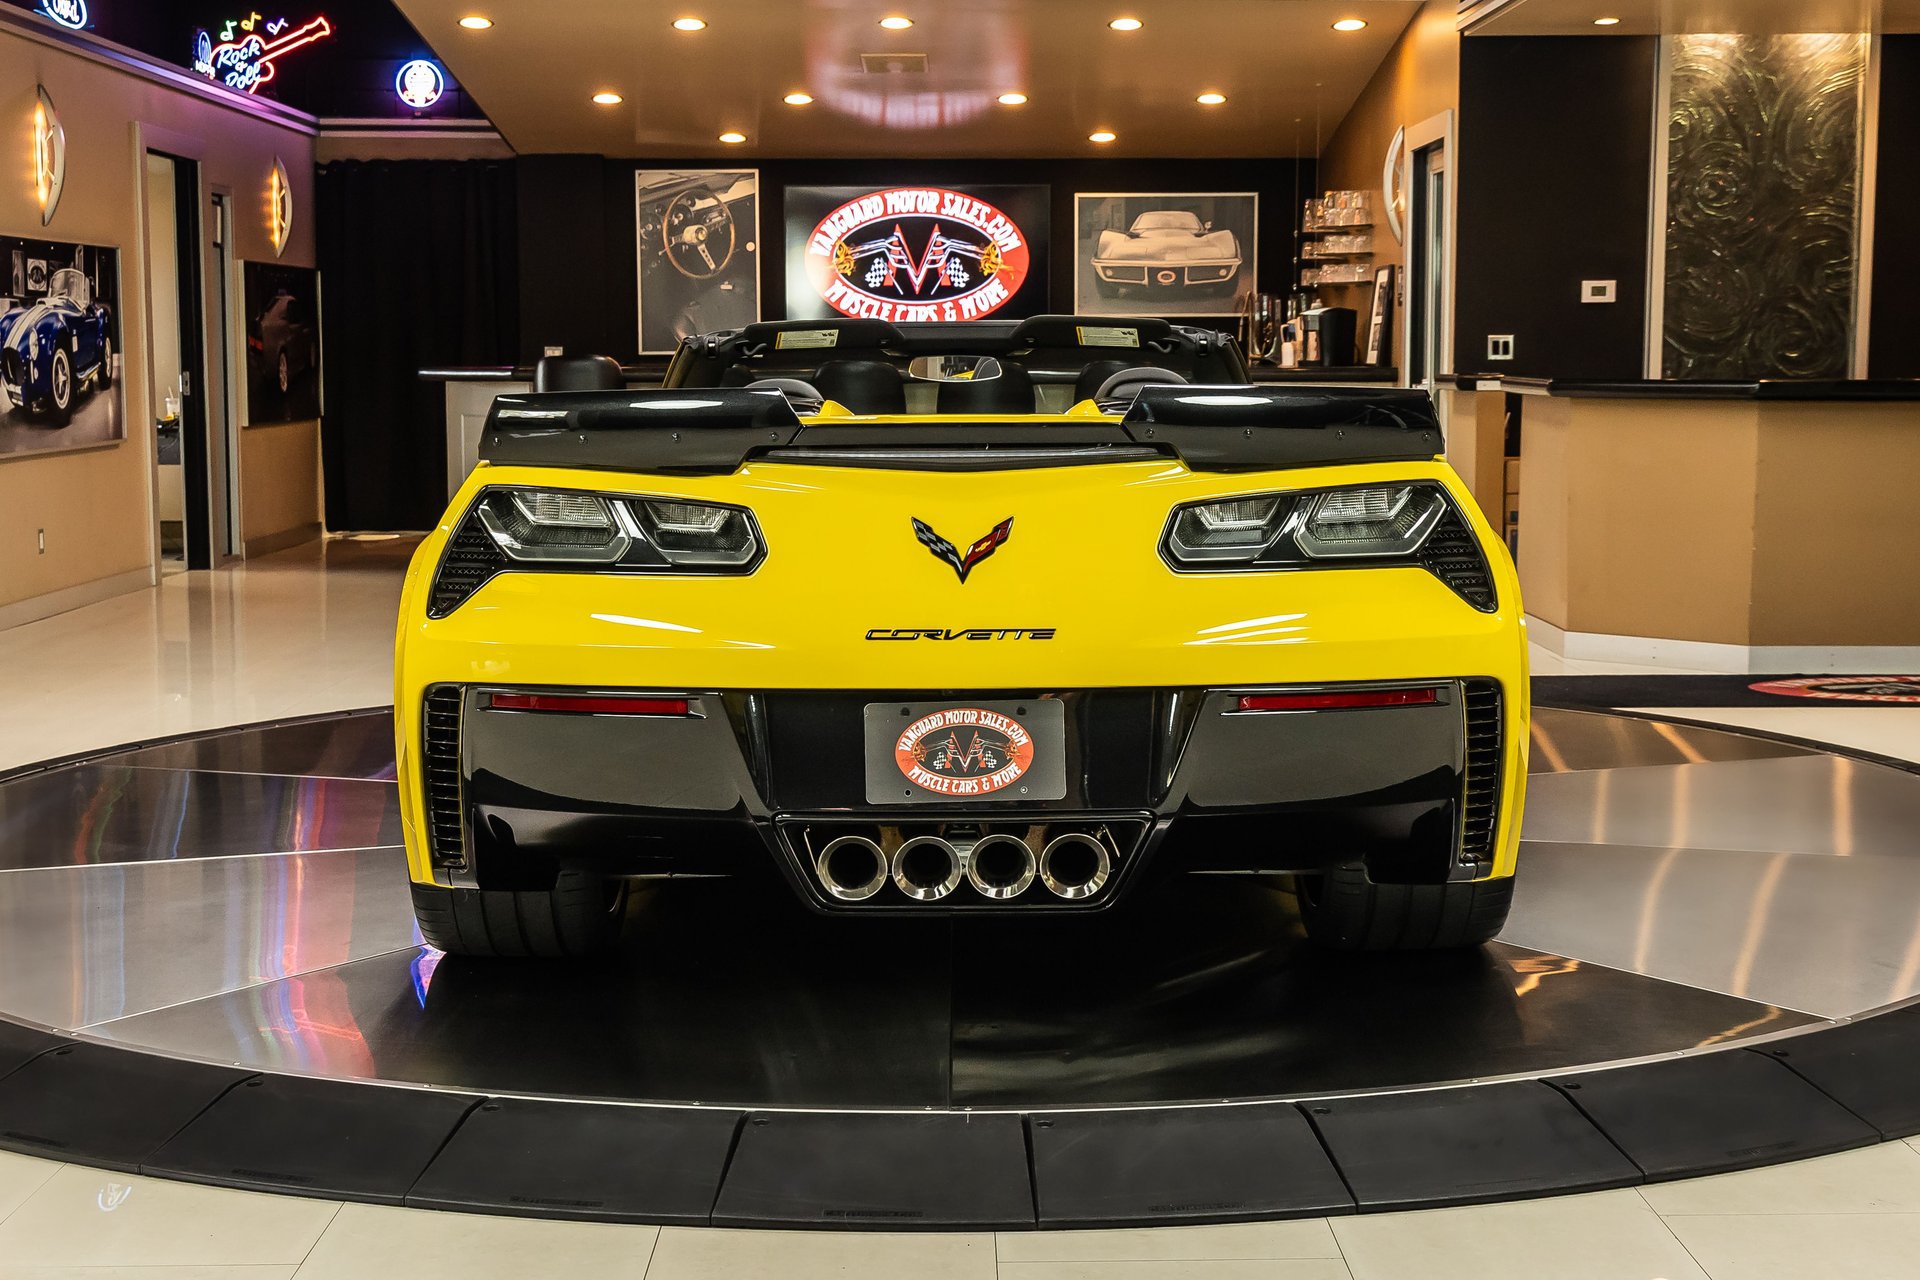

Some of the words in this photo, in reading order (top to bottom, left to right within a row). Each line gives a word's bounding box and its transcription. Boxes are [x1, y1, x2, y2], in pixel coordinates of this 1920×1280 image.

[217, 38, 261, 69] Rock
[809, 195, 885, 257] VANGUARD
[884, 190, 938, 214] MOTOR
[941, 192, 1022, 253] SALES.COM
[823, 279, 893, 321] MUSCLE
[893, 303, 939, 322] CARS
[943, 302, 957, 321] &
[960, 277, 1009, 318] MORE
[865, 628, 1057, 641] CORVETTE
[898, 712, 944, 752] VANGUARD
[945, 710, 978, 725] MOTOR
[979, 710, 1029, 747] SALES.COM
[907, 765, 949, 792] MUSCLE
[951, 778, 979, 793] CARS
[982, 777, 991, 790] &
[992, 762, 1022, 788] MORE
